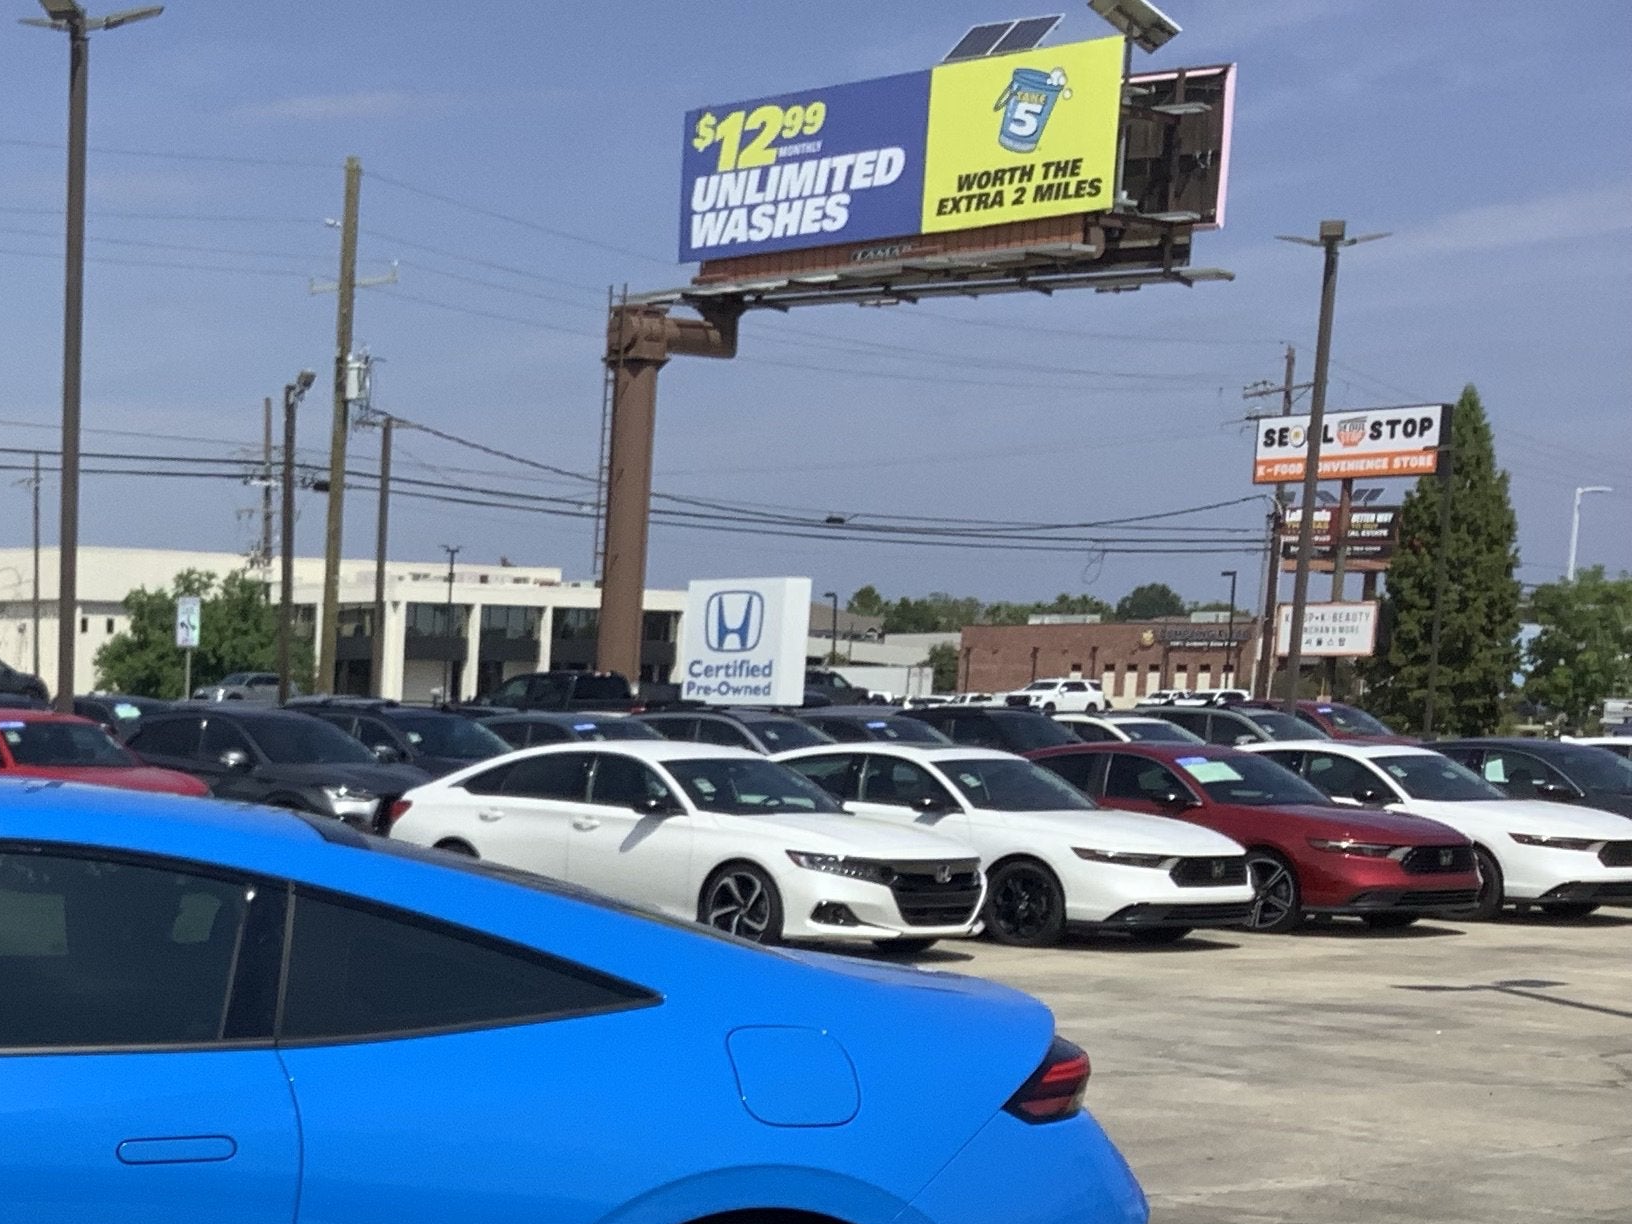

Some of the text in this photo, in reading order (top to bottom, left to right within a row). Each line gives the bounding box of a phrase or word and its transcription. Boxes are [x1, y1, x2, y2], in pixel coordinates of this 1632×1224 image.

[1008, 102, 1043, 136] 5
[691, 147, 906, 213] UNLIMITED
[957, 158, 1083, 193] WORTH THE
[936, 178, 1103, 216] EXTRA 2 MILES
[690, 193, 851, 248] WASHES
[1369, 417, 1434, 441] STOP
[1318, 457, 1389, 473] ONVENIENCE
[1393, 453, 1434, 468] STORE
[688, 659, 773, 678] Certified
[686, 681, 772, 696] Pre-Owned
